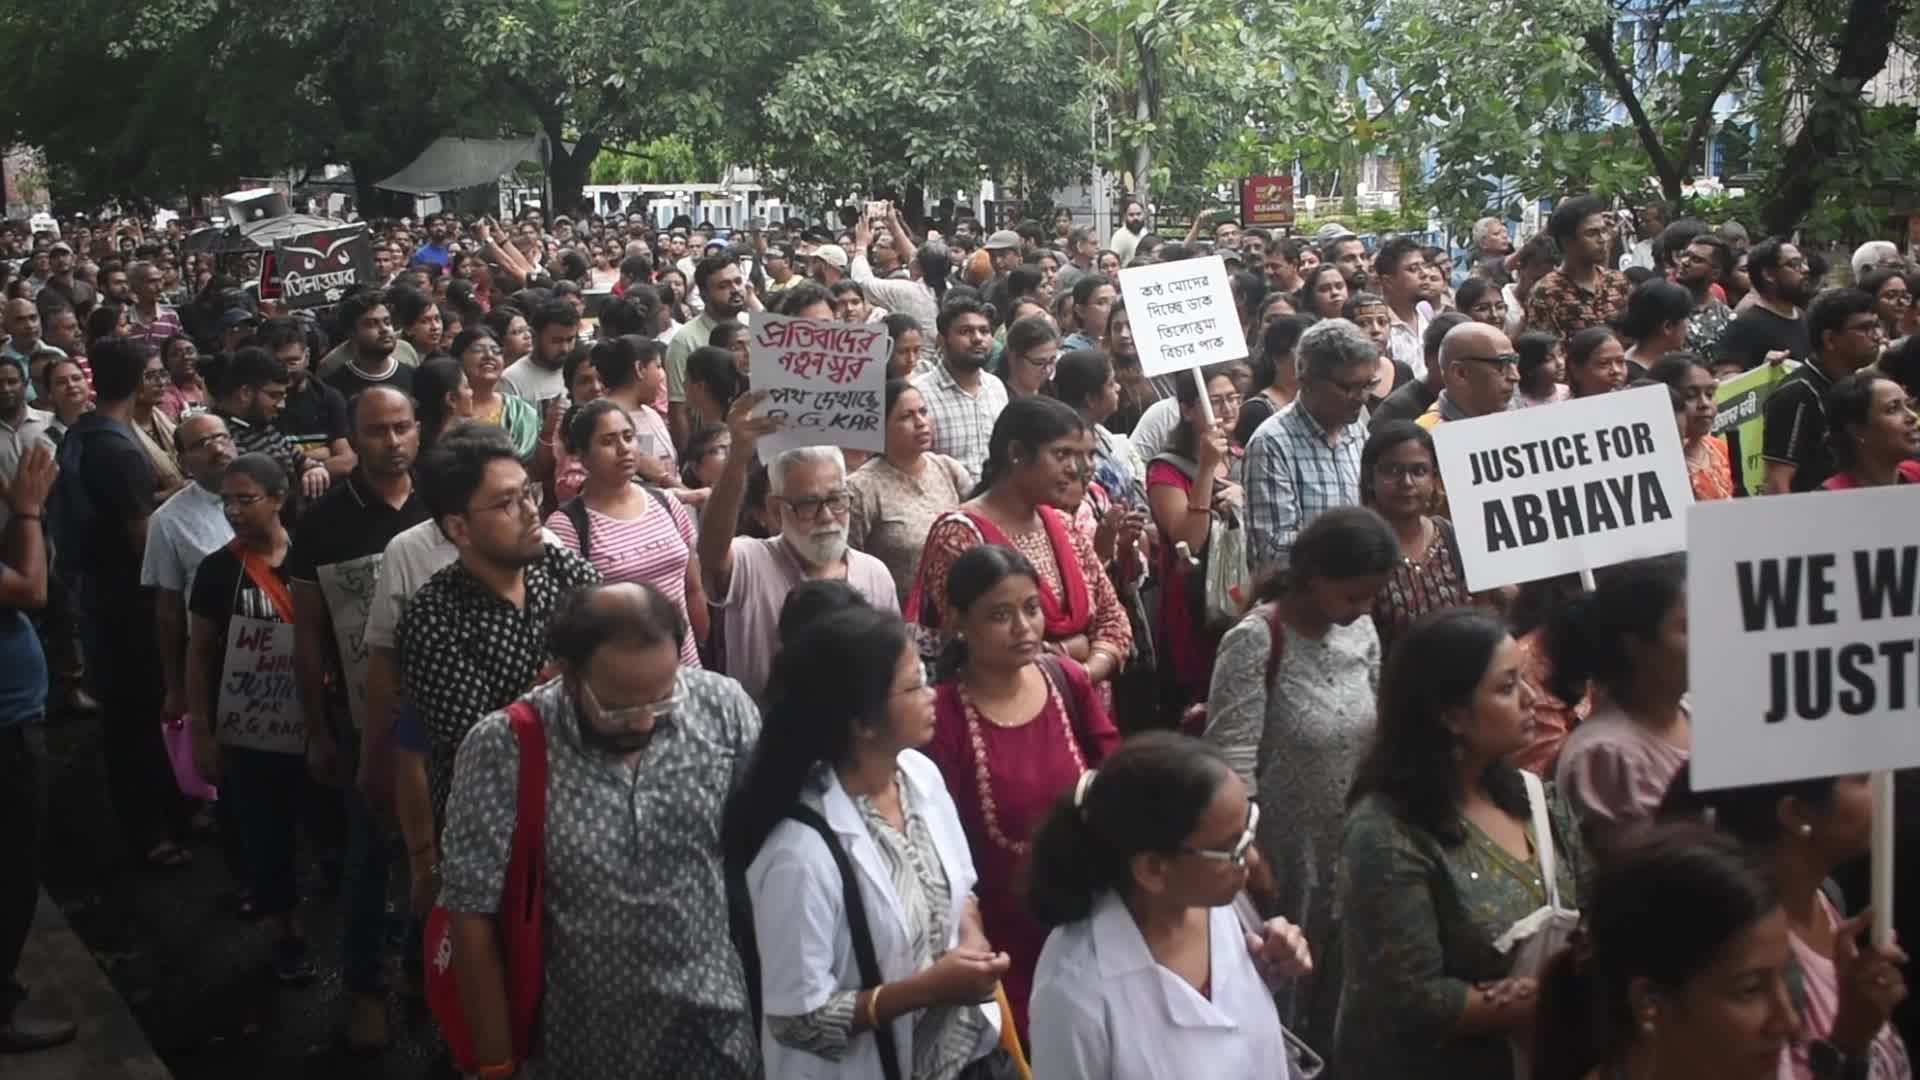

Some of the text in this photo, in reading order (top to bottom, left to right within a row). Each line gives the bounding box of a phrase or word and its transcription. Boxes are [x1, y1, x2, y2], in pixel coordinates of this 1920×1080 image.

[1168, 275, 1209, 294] মোদের
[1146, 295, 1213, 319] দিচ্ছে ডাক
[756, 319, 882, 354] প্রতিবাদের
[1156, 317, 1217, 339] তিলোত্তমা
[1159, 336, 1224, 361] বিচার পাক
[778, 351, 827, 380] নতুন
[769, 387, 813, 405] পথ
[1469, 422, 1655, 486] JUSTICE FOR
[1482, 470, 1673, 553] ABHAYA
[1735, 544, 1920, 633] WE W
[236, 625, 273, 652] WE
[1763, 638, 1920, 725] JUST
